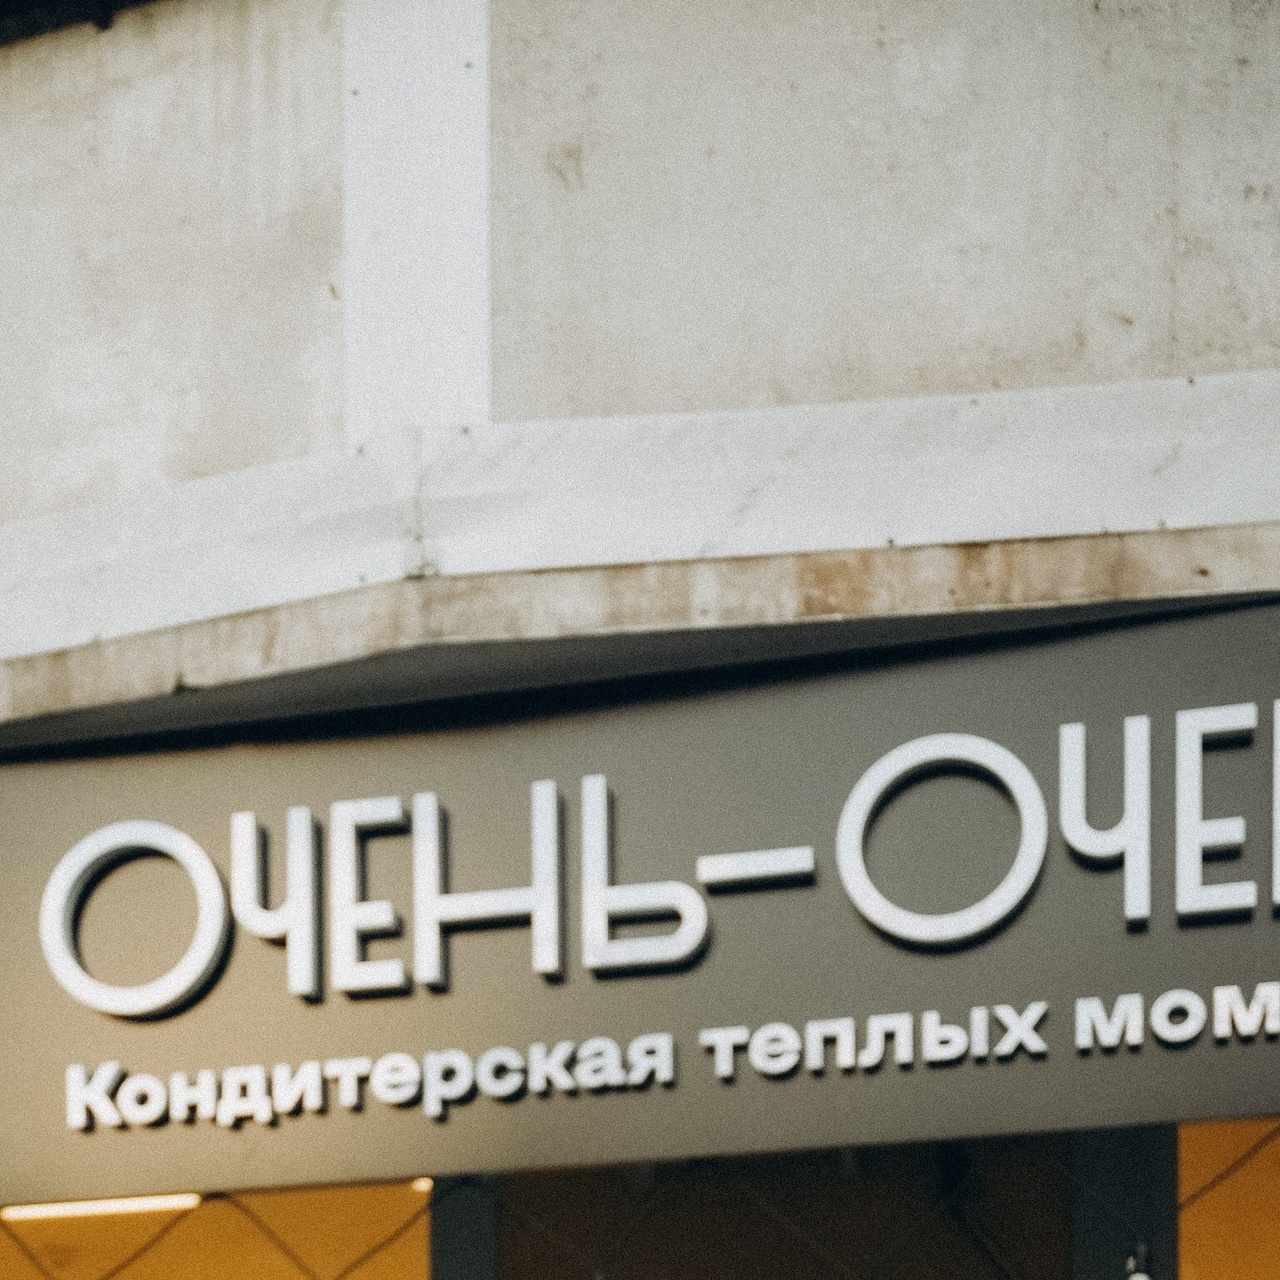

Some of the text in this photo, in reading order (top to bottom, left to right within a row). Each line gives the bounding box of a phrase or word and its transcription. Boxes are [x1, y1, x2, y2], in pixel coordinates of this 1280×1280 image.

[39, 698, 1280, 1017] ОЧЕНЬ-ОЧЕ
[65, 1032, 675, 1130] Кондитерская
[699, 1001, 1050, 1078] теплых
